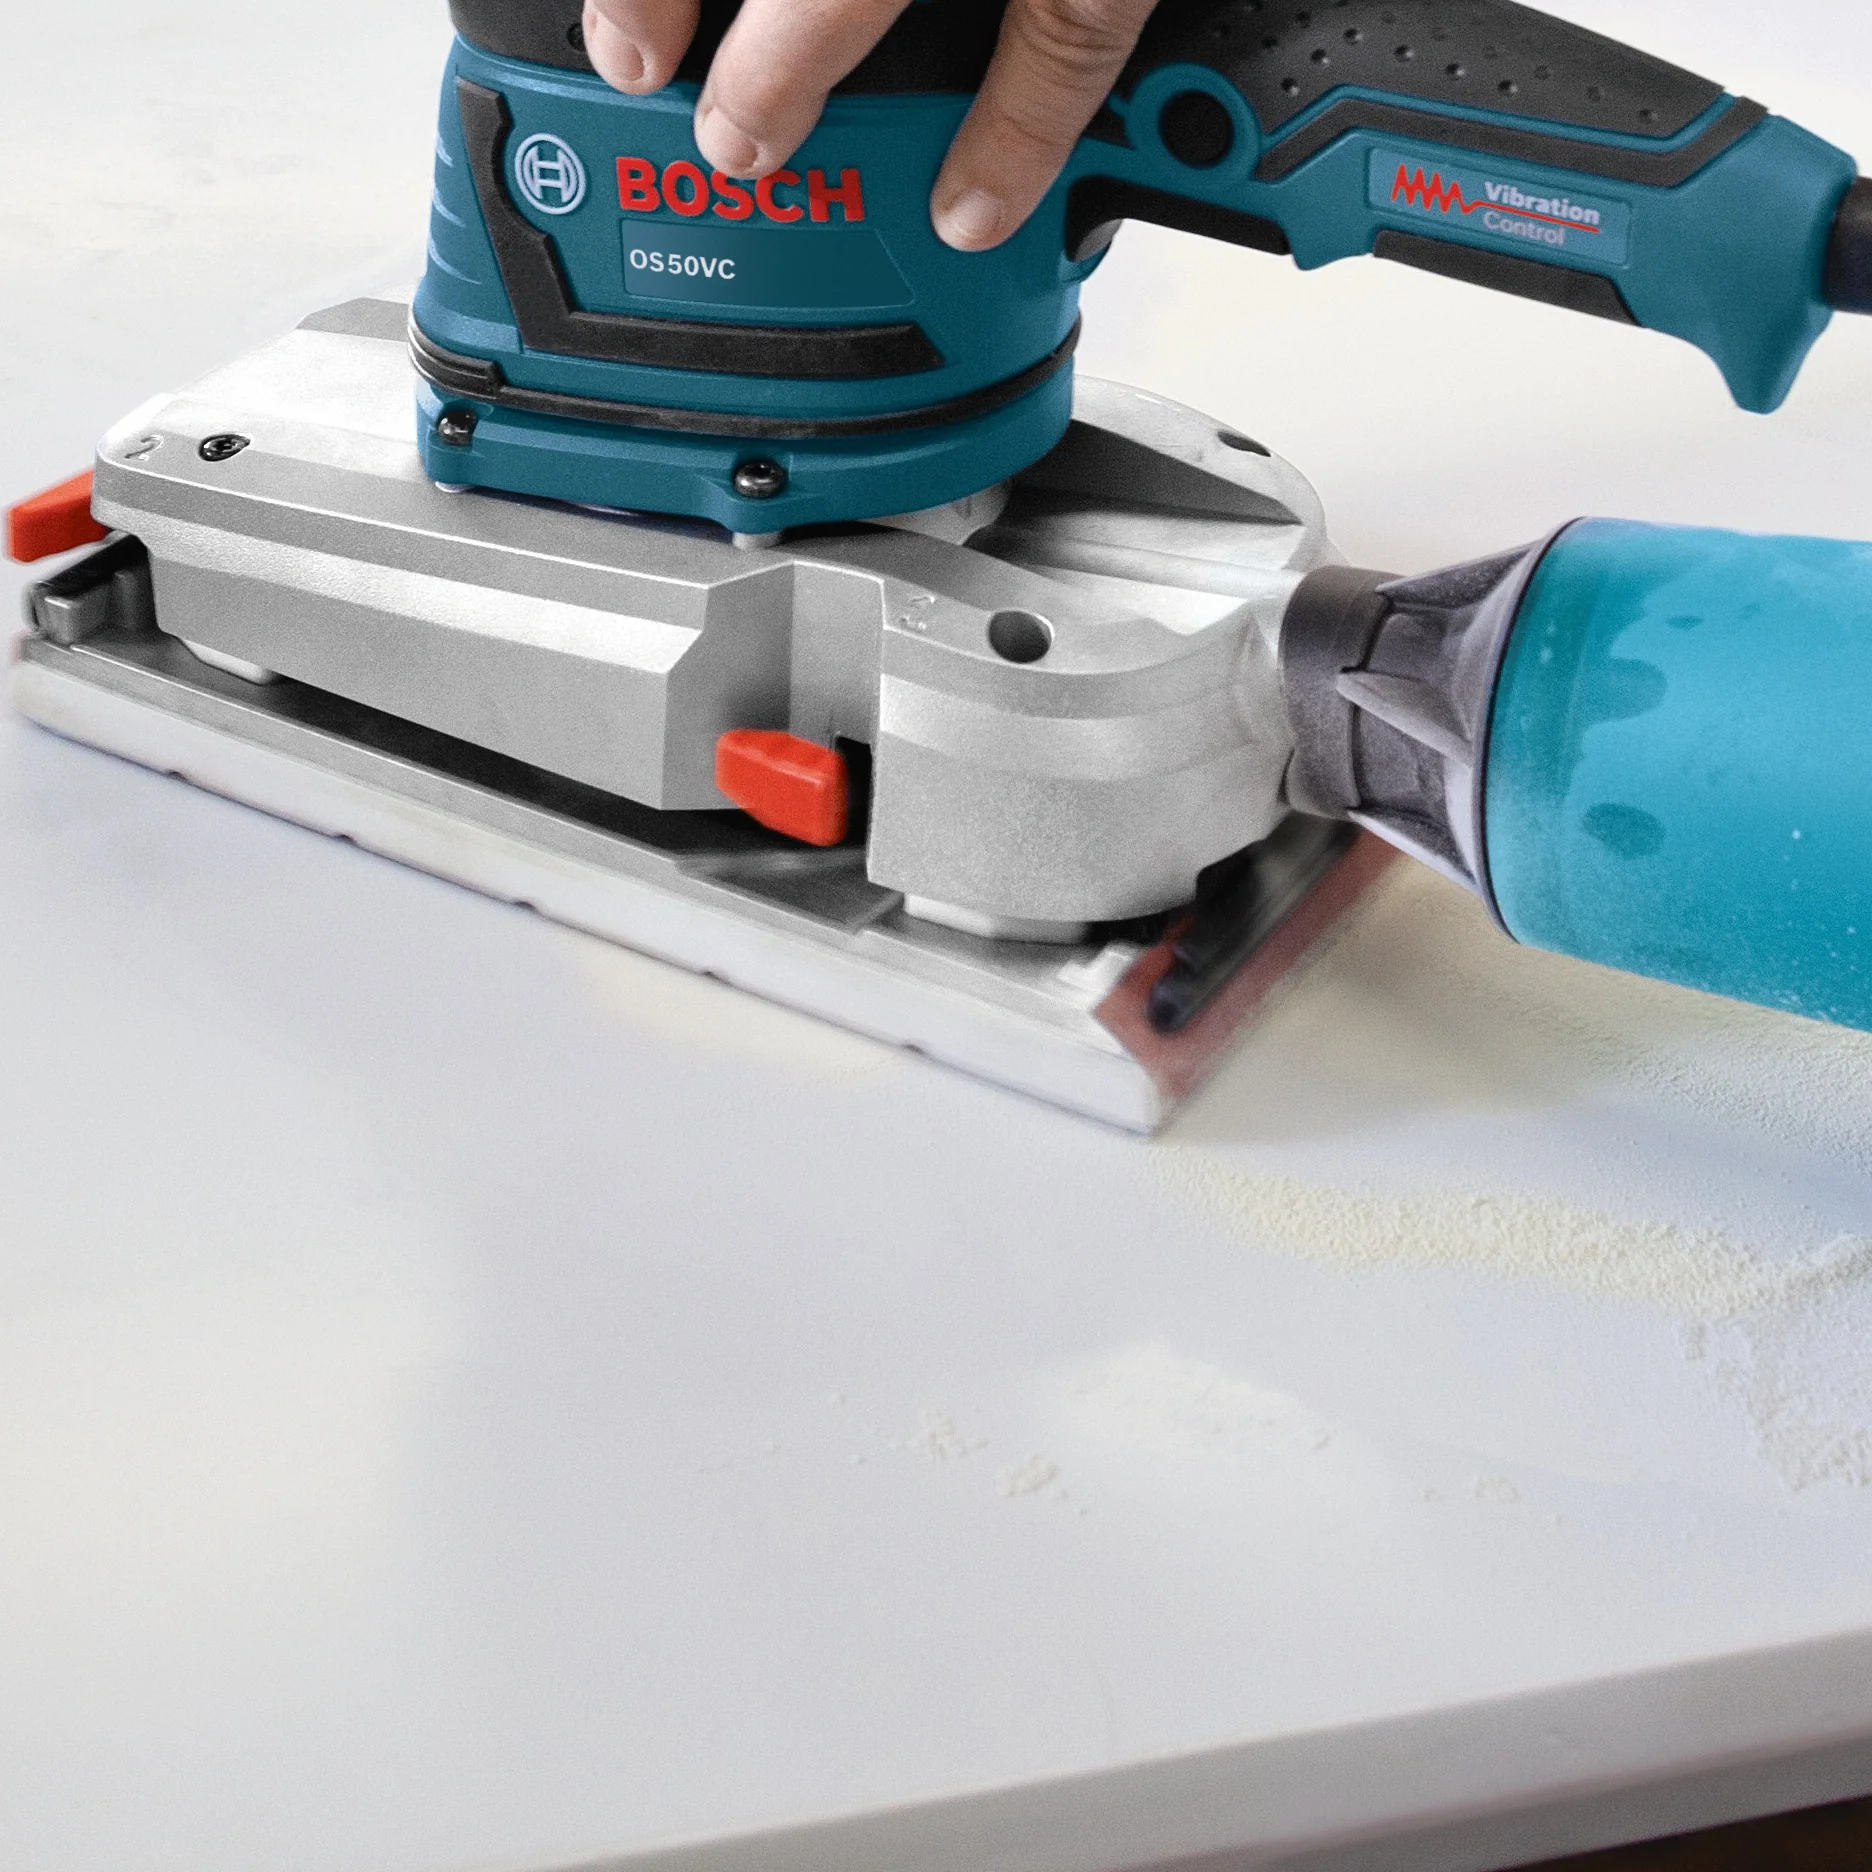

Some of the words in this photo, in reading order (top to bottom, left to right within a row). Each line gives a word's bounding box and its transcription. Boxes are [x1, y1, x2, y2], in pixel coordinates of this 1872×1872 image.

[616, 156, 866, 223] BOSCH
[1483, 180, 1600, 225] Vibration
[1482, 211, 1566, 246] Control
[629, 248, 737, 280] OS50VC
